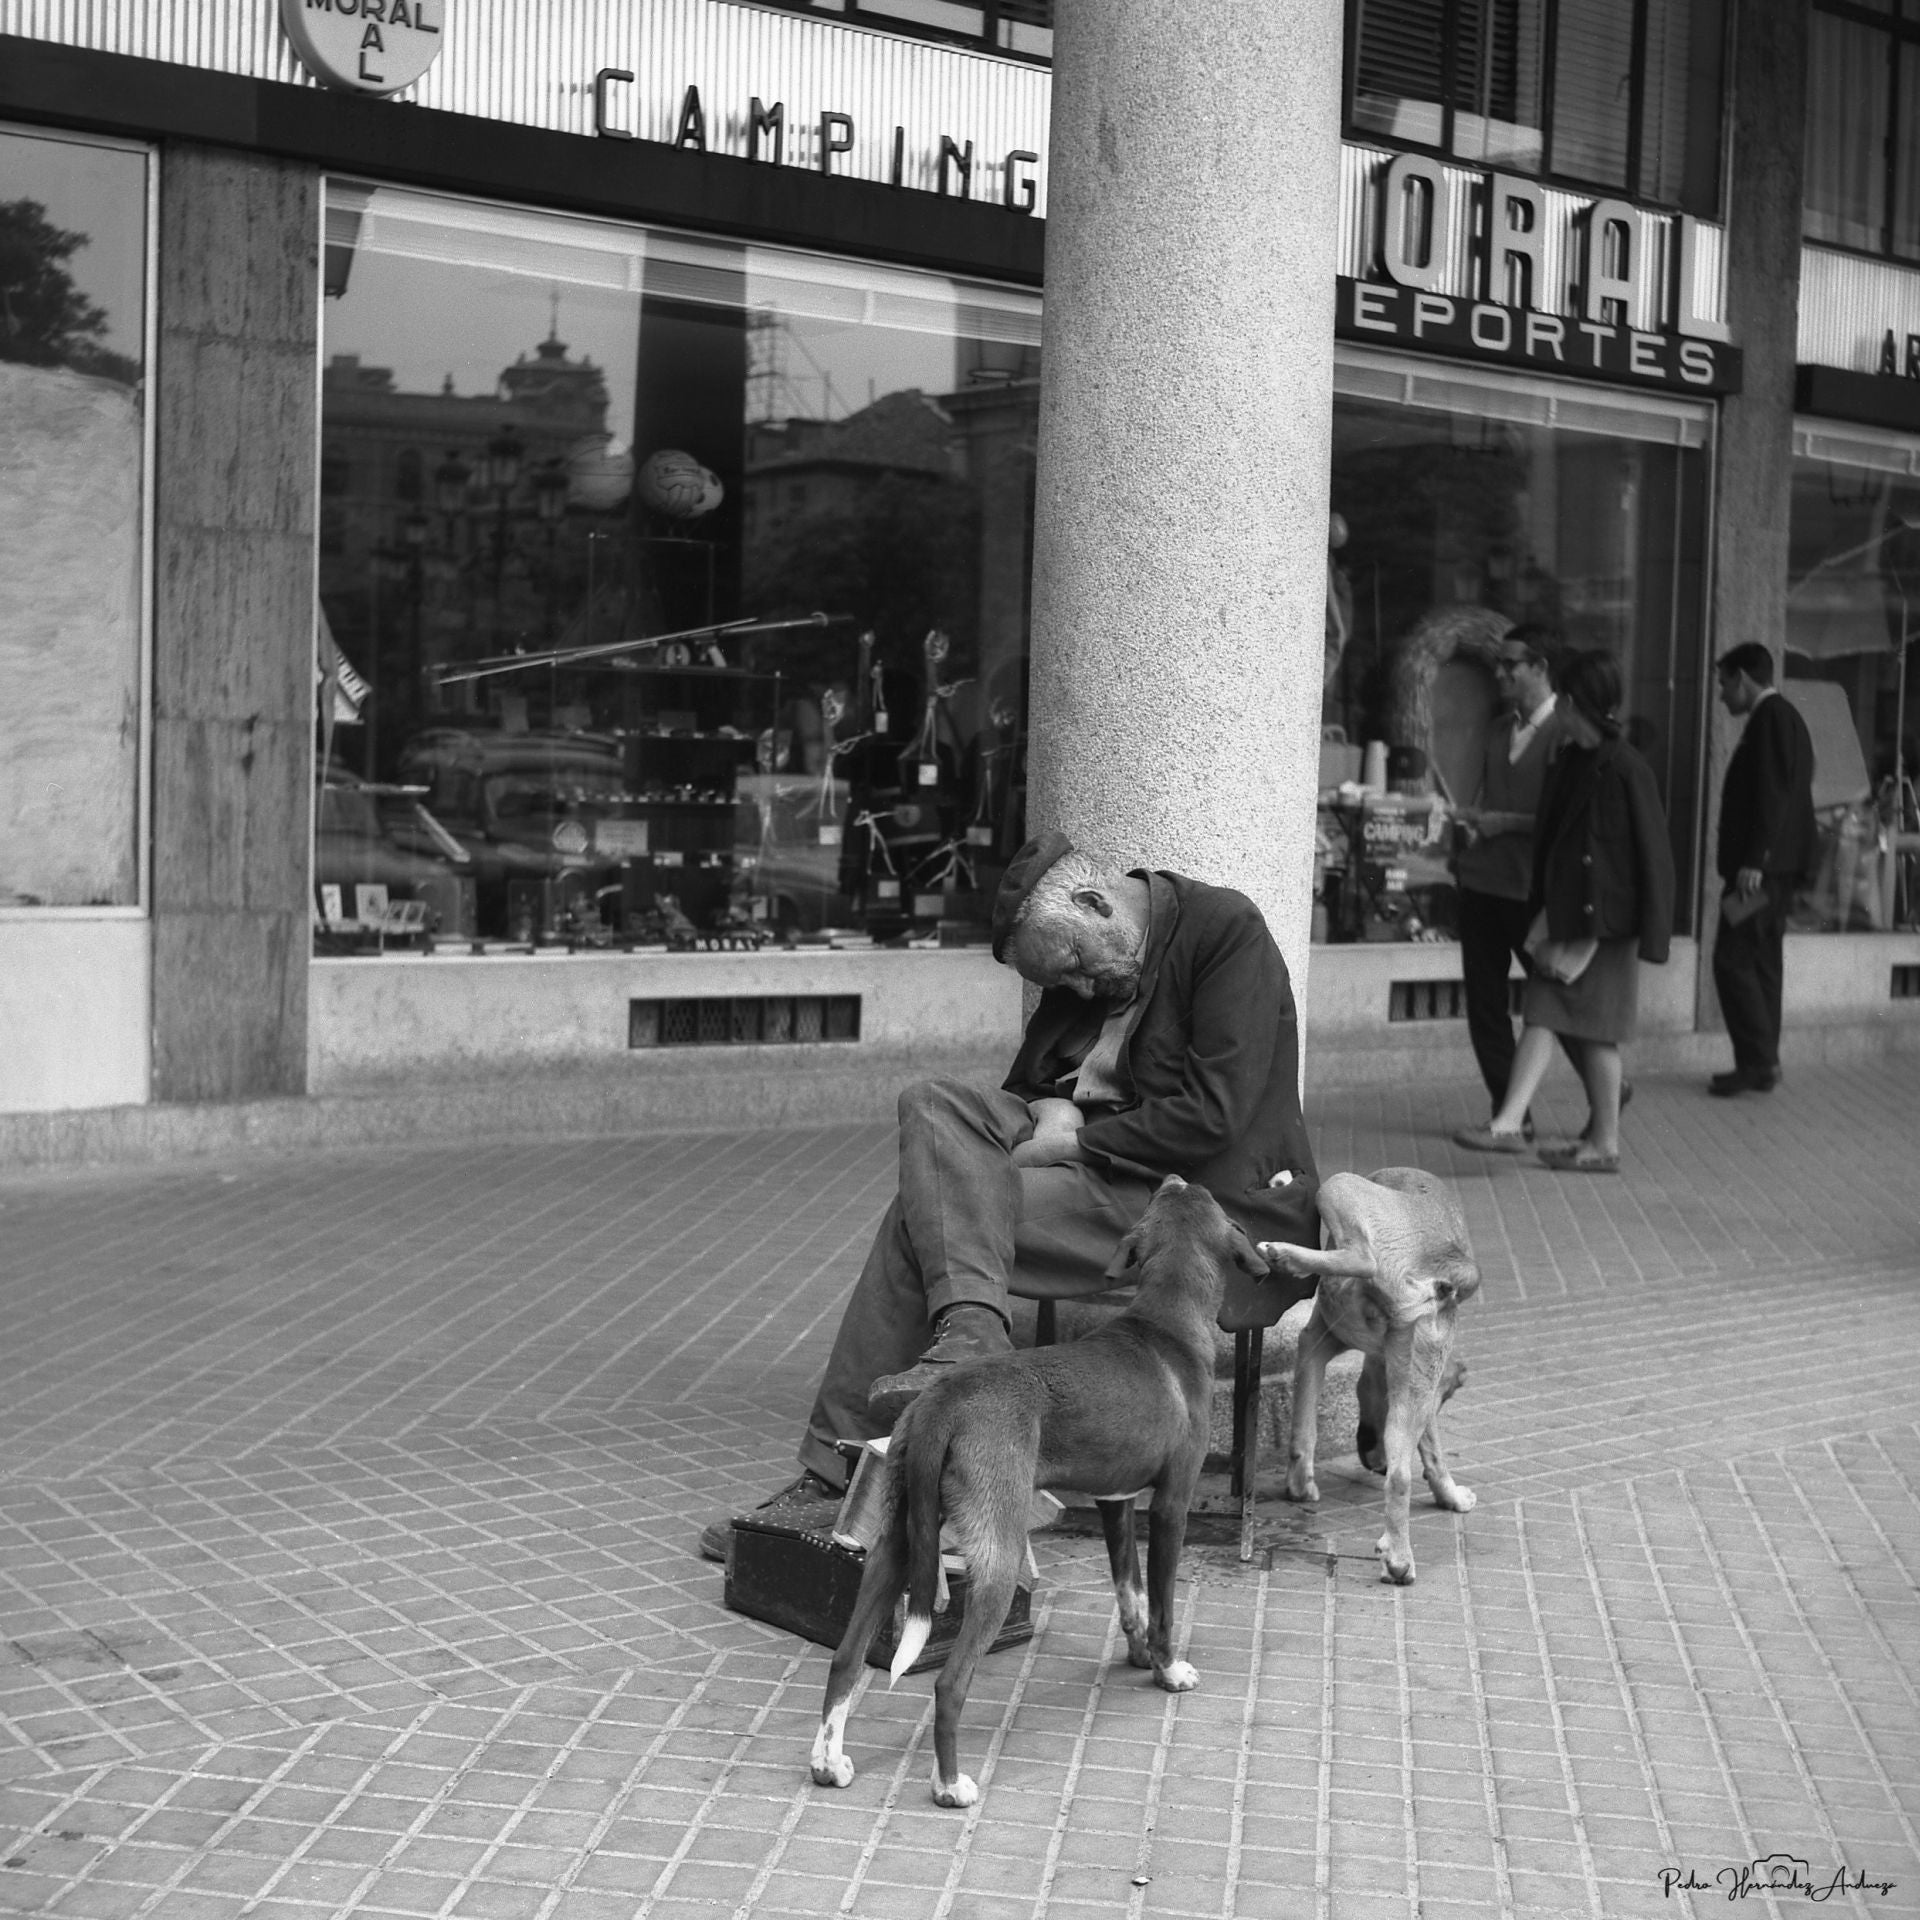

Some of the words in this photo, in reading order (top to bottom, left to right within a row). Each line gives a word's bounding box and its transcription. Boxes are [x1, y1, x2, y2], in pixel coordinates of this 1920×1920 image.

[597, 68, 1038, 213] CAMPING
[1383, 152, 1731, 343] ORAL
[1336, 281, 1715, 385] EPORTES
